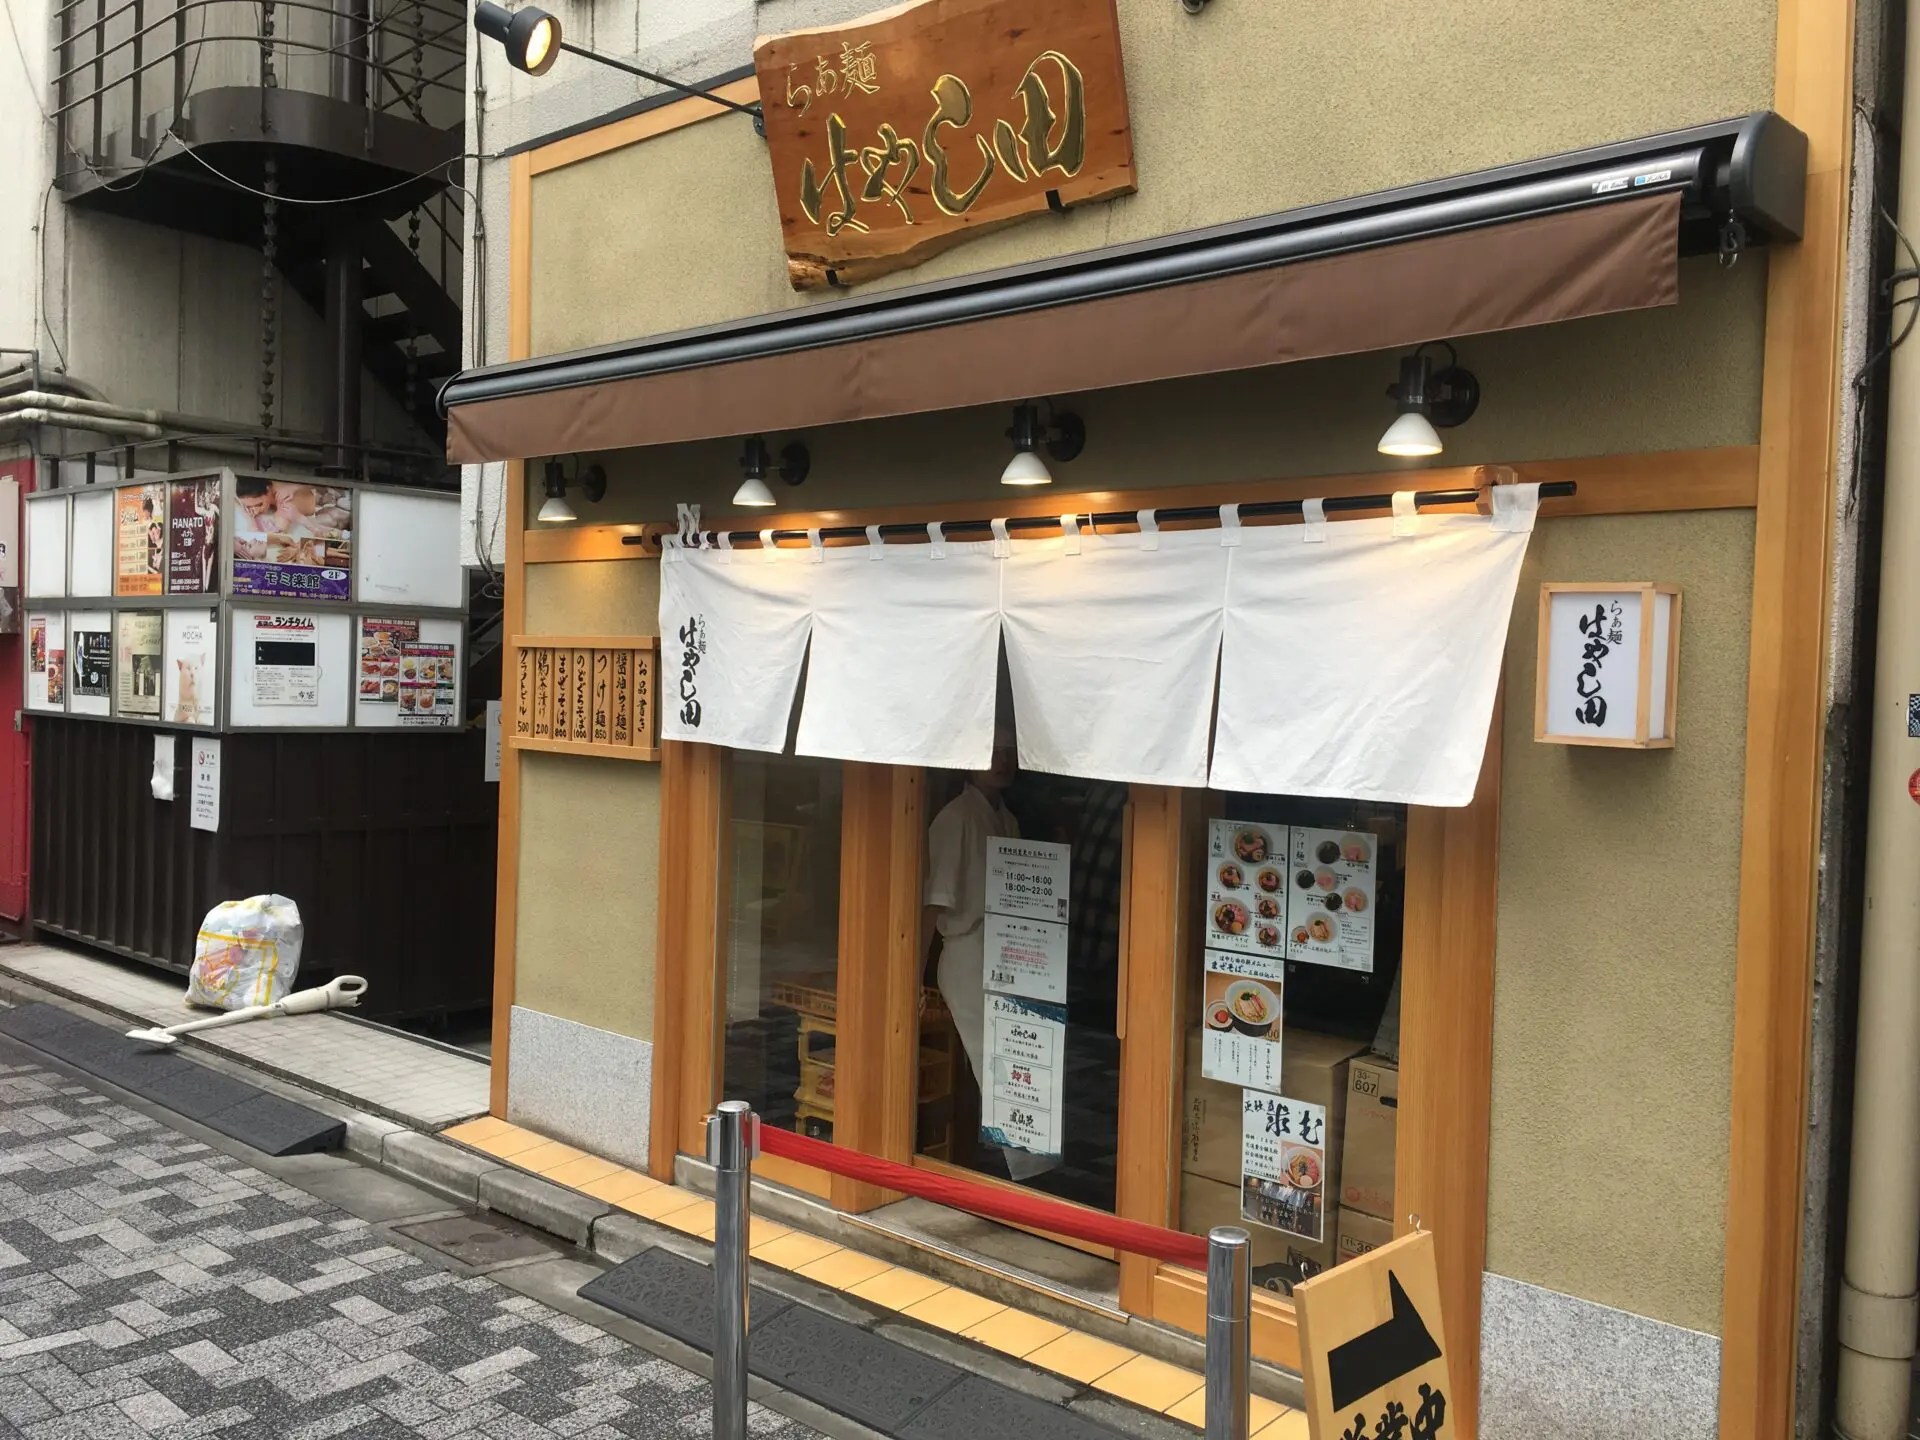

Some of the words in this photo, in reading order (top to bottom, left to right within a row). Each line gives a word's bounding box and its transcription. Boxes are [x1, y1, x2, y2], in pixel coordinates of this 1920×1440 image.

[799, 50, 1086, 237] はやし田
[172, 517, 203, 529] HANATO
[264, 571, 320, 589] モミ楽館
[328, 571, 340, 579] 2F
[275, 616, 314, 628] ランチタイム
[1607, 599, 1623, 645] らぁ麺
[679, 616, 702, 728] はやし田
[1575, 603, 1610, 728] はやし田
[520, 648, 528, 716] クラフトビール
[557, 654, 568, 727] まぜそば
[575, 655, 586, 729] のどぐろそば
[595, 655, 608, 728] つけ麺
[517, 720, 530, 733] 500
[535, 723, 549, 735] 200
[554, 729, 567, 738] 800
[573, 729, 586, 739] 1000
[594, 729, 607, 740] 850
[615, 731, 627, 741] 800
[1355, 1079, 1378, 1095] 607
